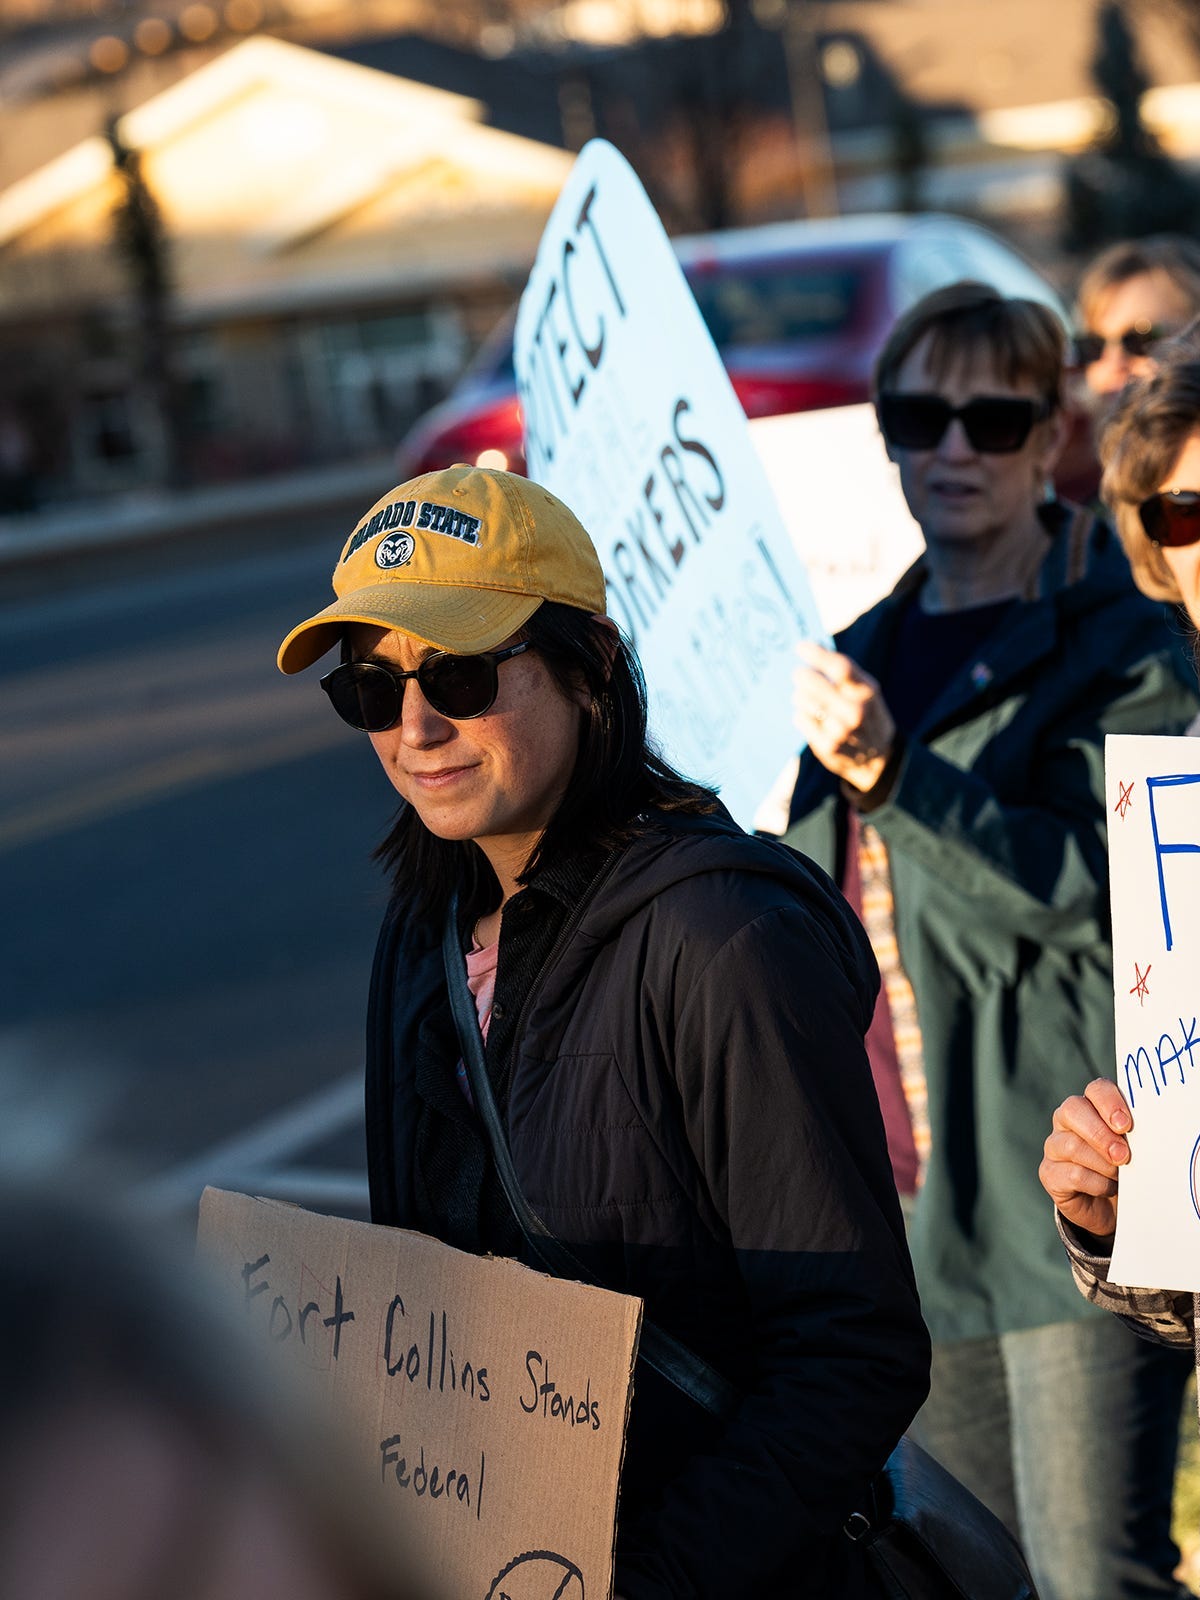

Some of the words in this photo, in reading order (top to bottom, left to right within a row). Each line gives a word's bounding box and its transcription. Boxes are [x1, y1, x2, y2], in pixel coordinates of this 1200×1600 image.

[414, 500, 482, 547] STATE
[604, 398, 728, 650] ORKERS
[240, 1253, 355, 1361] Fort
[383, 1294, 491, 1403] Collins
[518, 1350, 602, 1431] Stands
[379, 1434, 486, 1521] Federal
